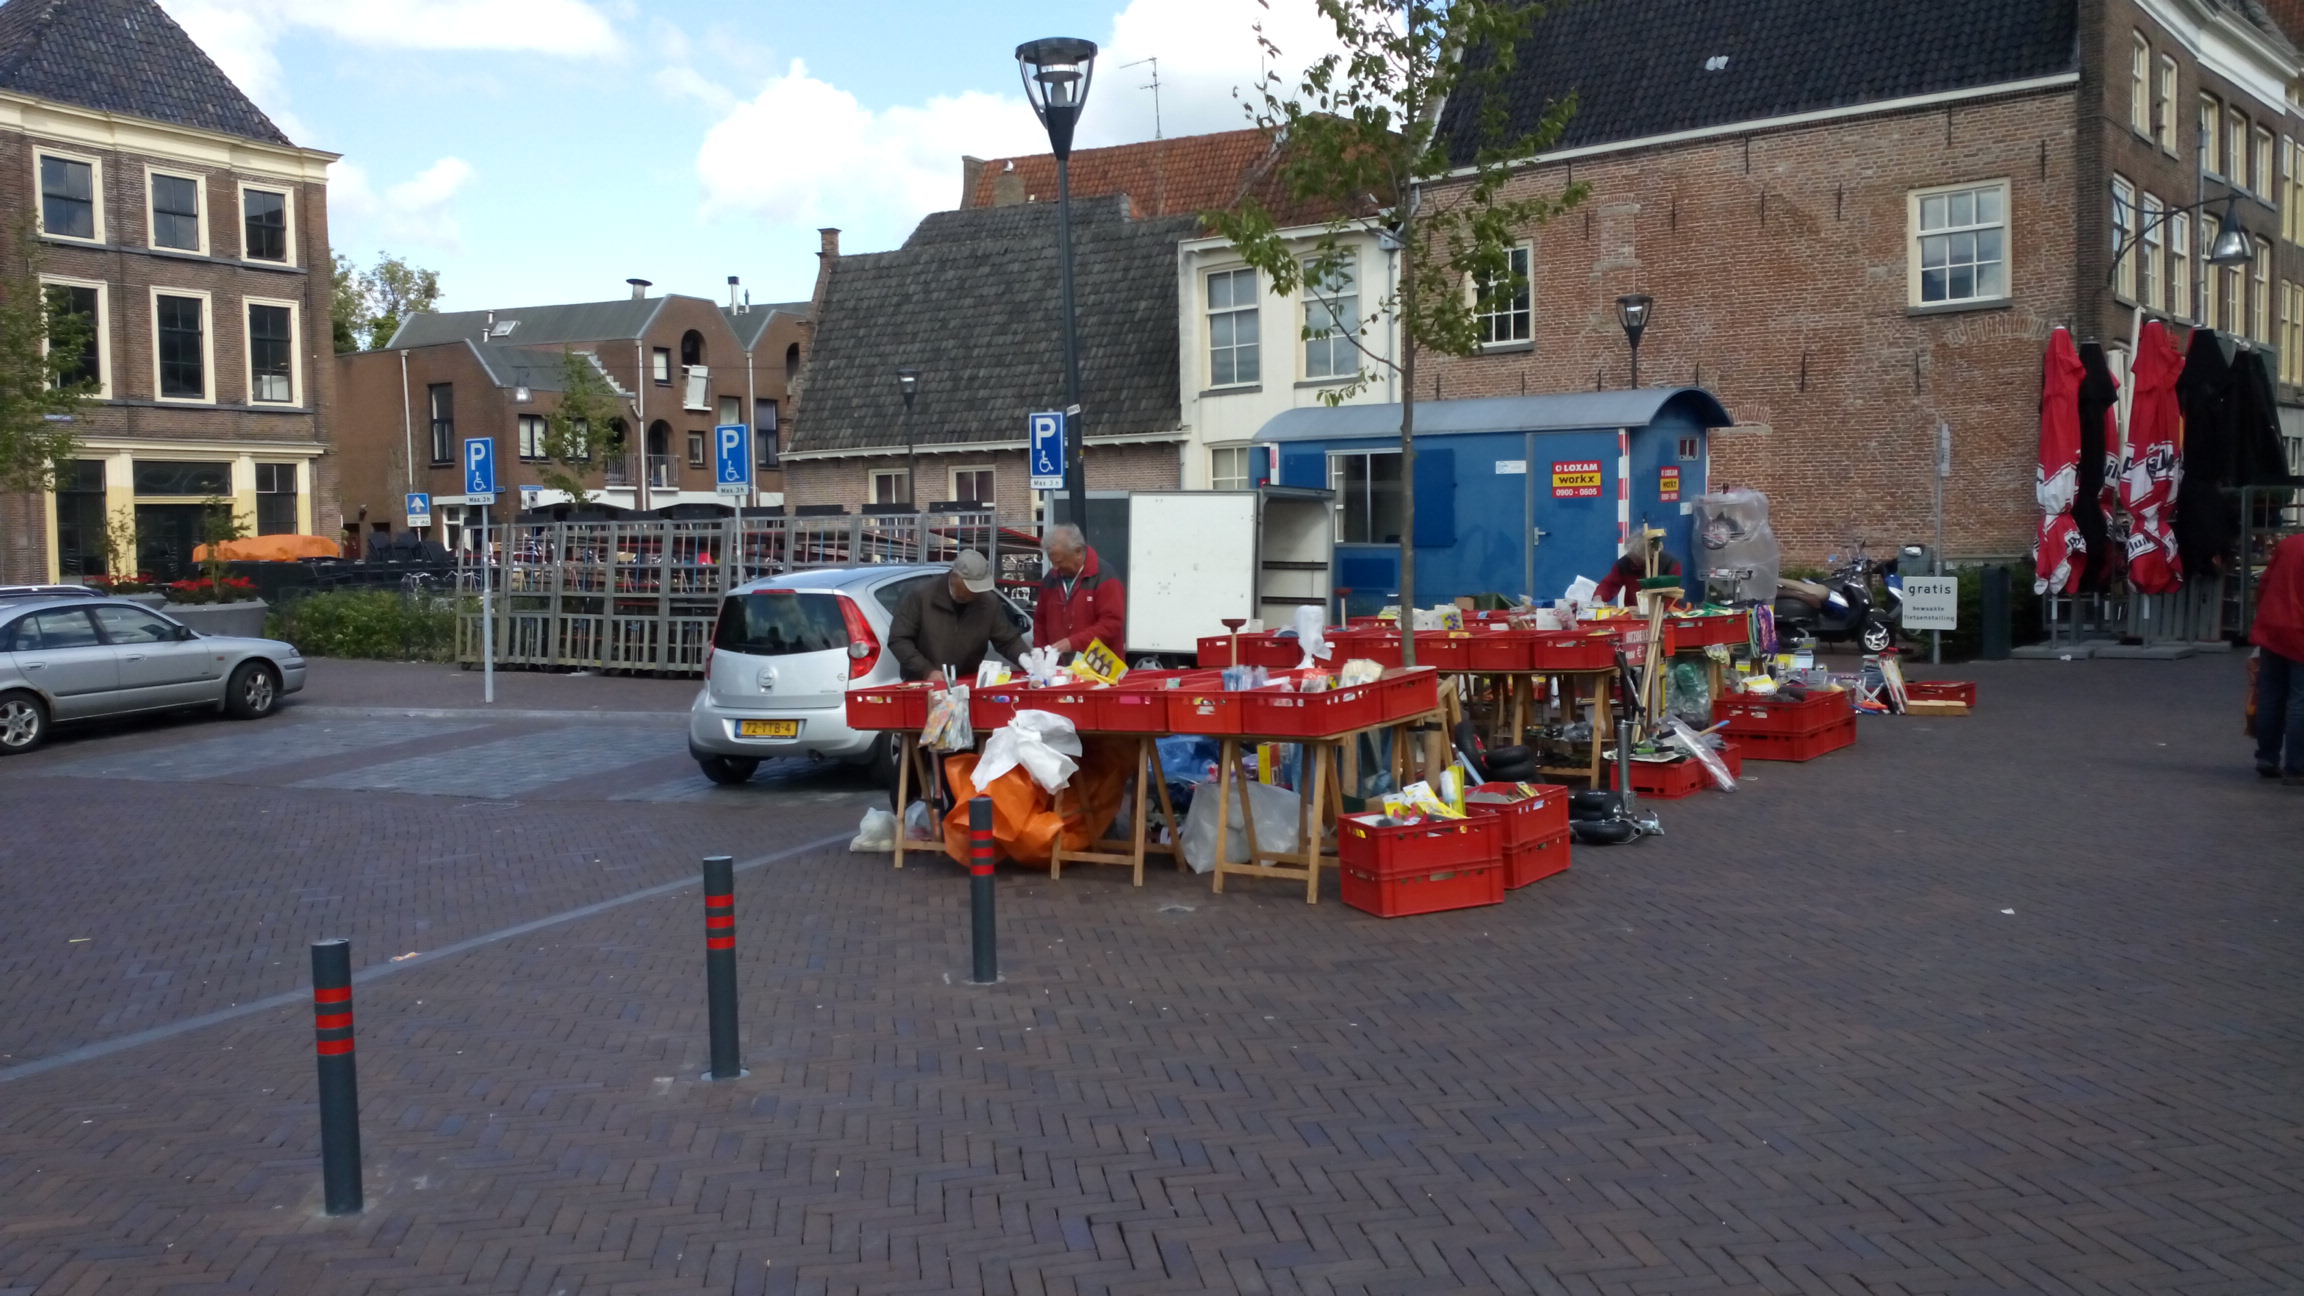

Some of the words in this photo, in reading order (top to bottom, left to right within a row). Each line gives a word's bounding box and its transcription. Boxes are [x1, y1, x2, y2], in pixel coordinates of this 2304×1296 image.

[1035, 417, 1056, 449] P
[722, 429, 739, 459] P
[470, 442, 485, 470] P
[1563, 463, 1598, 472] LOXAM
[1558, 474, 1595, 484] workx
[1908, 584, 1951, 596] gratis
